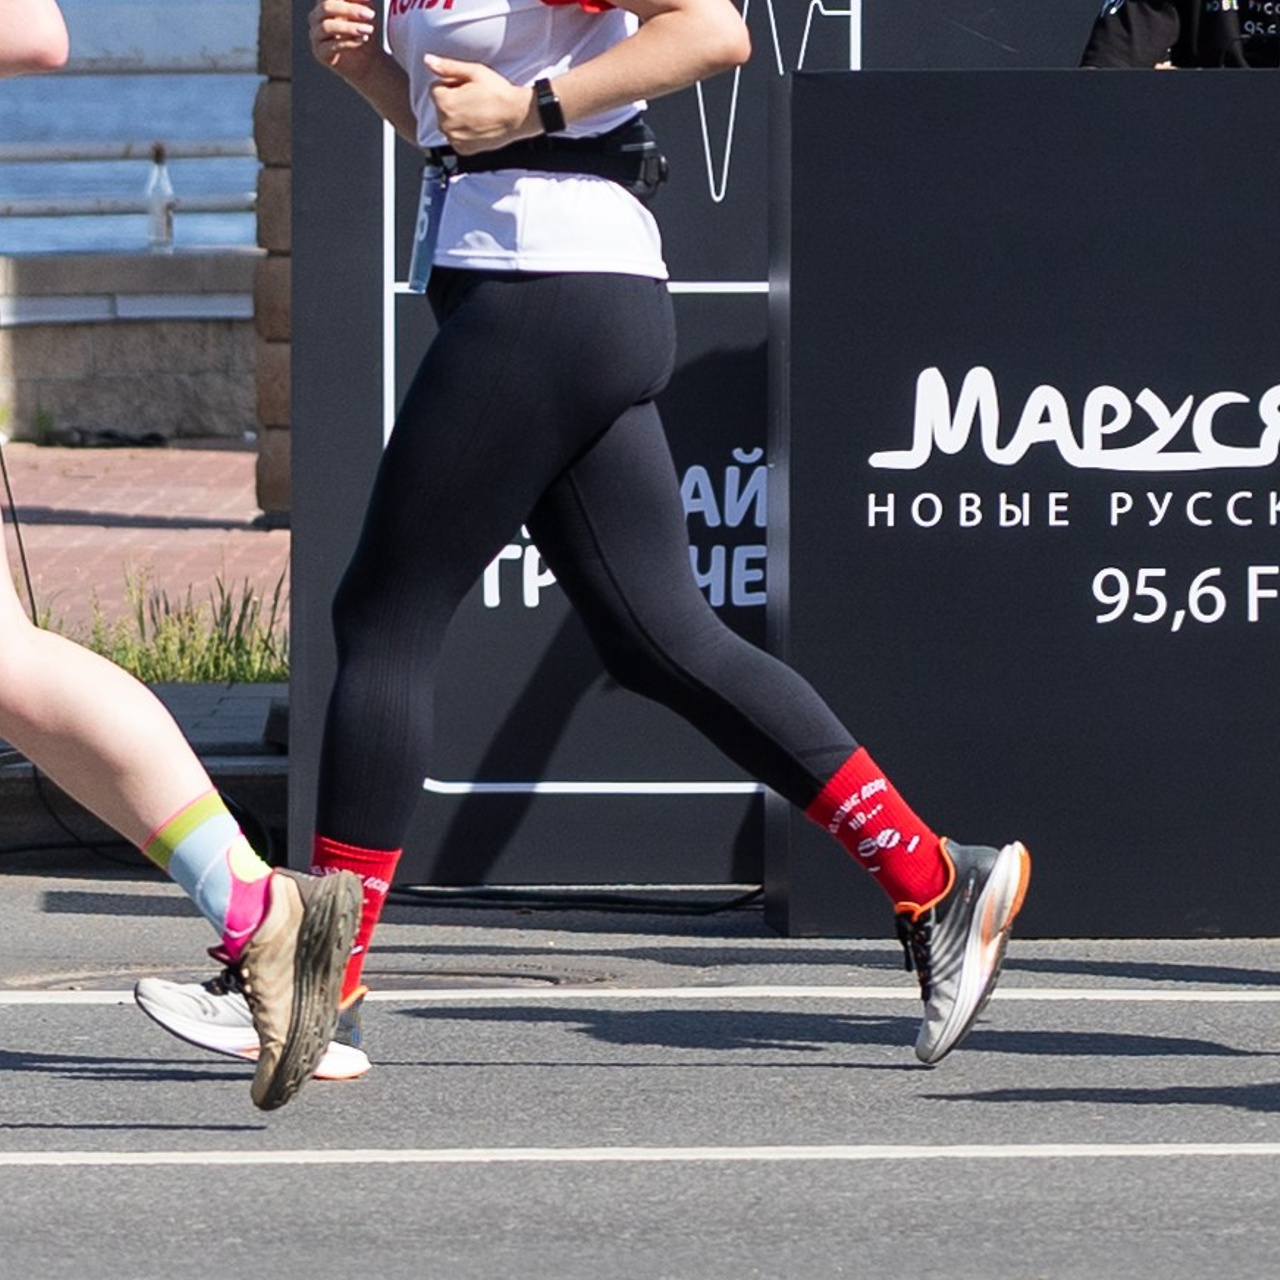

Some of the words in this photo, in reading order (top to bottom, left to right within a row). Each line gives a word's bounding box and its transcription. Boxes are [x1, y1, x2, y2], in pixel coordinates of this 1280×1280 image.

[867, 491, 1070, 527] НОВЫЕ
[484, 544, 768, 607] ГРЧЕ
[1091, 566, 1227, 633] 95,6
